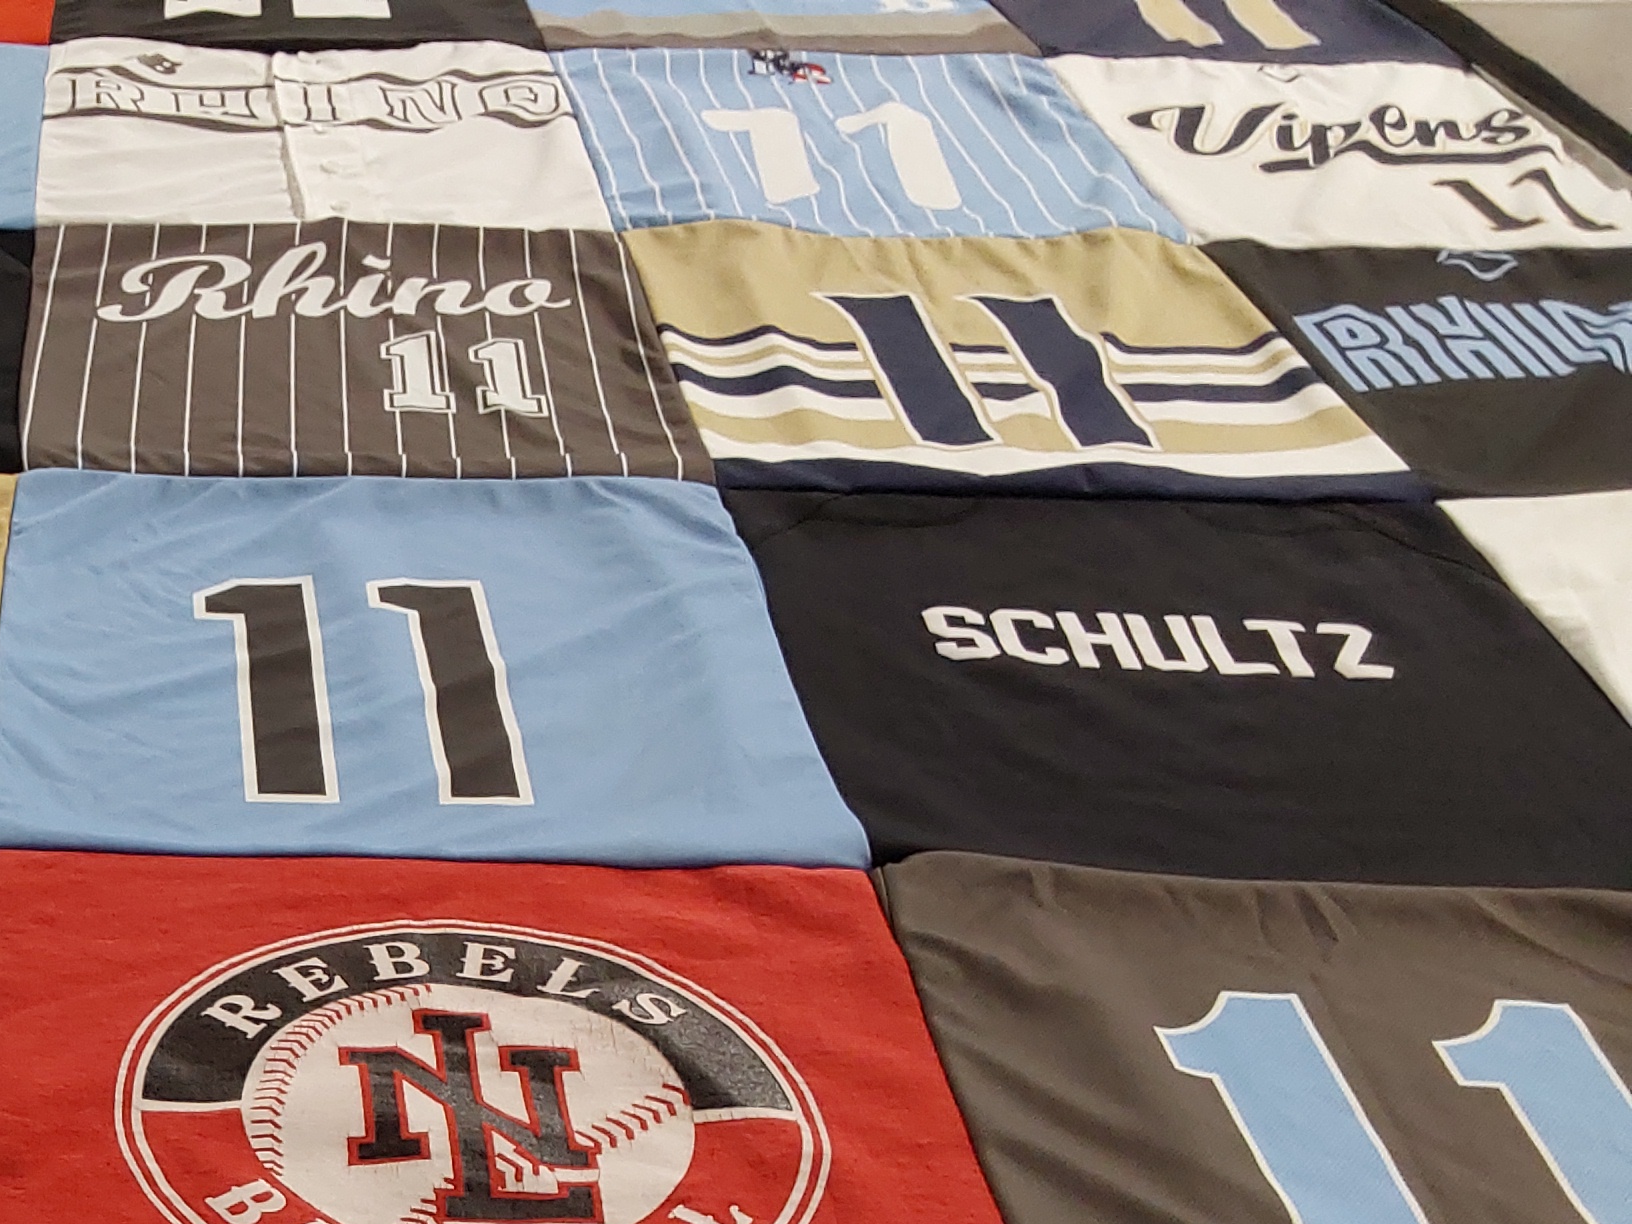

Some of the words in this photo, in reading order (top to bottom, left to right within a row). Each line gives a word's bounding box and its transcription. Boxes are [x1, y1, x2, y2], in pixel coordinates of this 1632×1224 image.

[68, 73, 561, 125] RHINO
[700, 102, 963, 211] 11
[1433, 168, 1619, 232] 11
[95, 241, 572, 323] Rhino
[380, 331, 551, 416] 11
[813, 293, 1163, 452] 11
[920, 604, 1396, 680] SCHULTZ
[192, 573, 536, 806] 11
[200, 940, 688, 1041] REBELS
